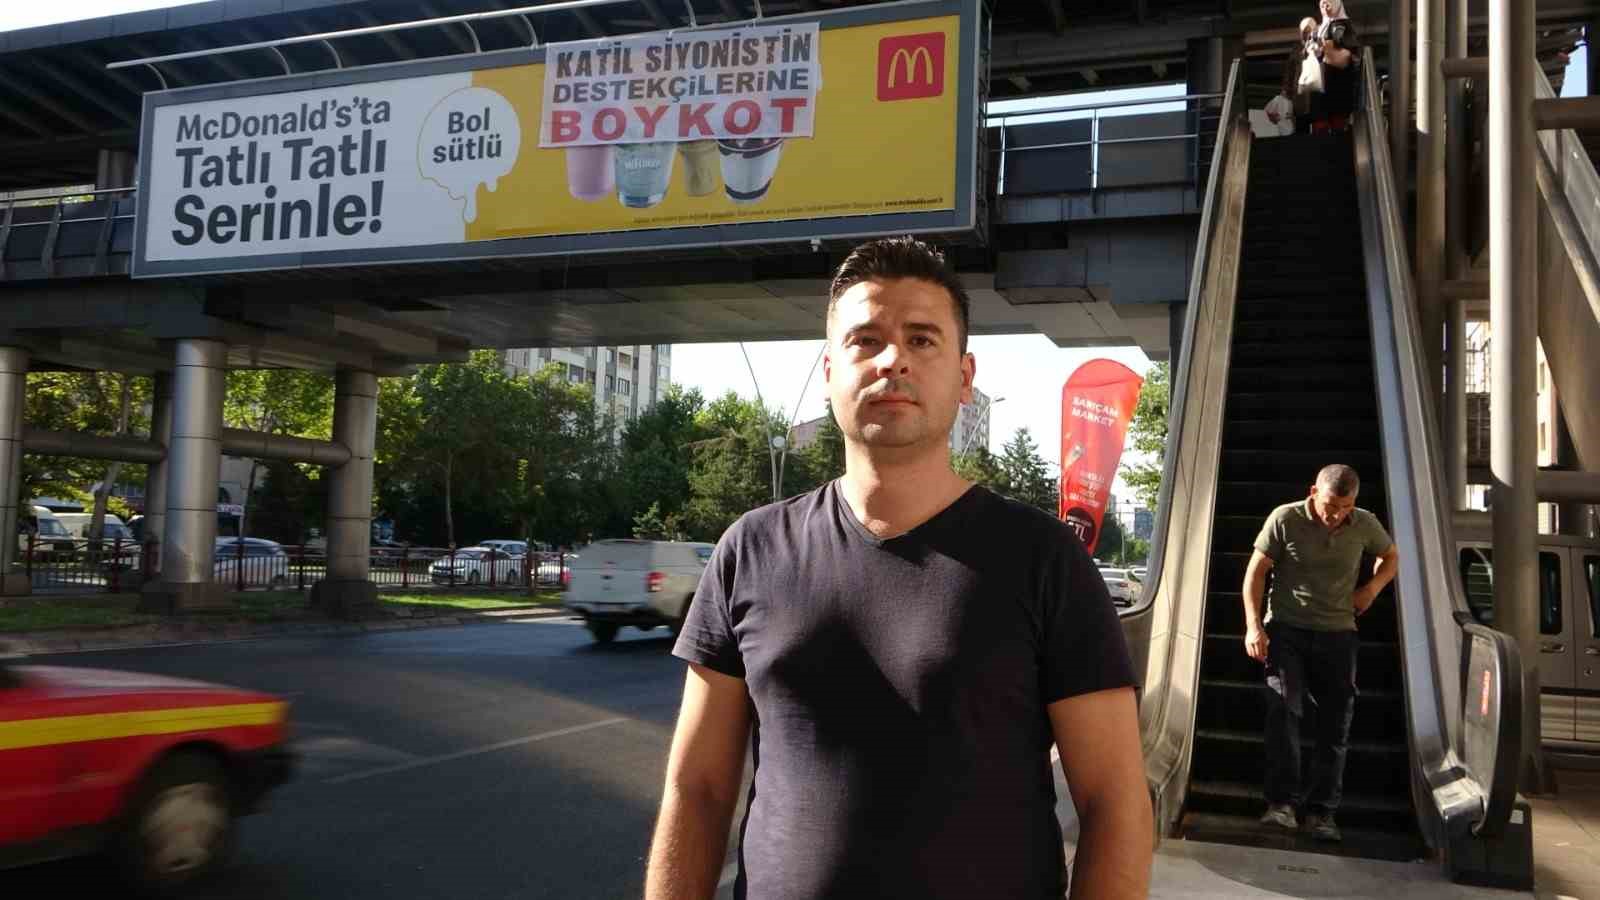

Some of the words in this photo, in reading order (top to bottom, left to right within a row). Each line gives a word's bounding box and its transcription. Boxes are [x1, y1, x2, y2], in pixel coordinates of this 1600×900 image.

[556, 41, 634, 79] KATİL
[645, 28, 812, 73] SİYONİSTİN
[447, 107, 491, 135] Bol
[550, 97, 808, 143] BOYKOT
[175, 141, 270, 188] Tatlı
[283, 129, 387, 181] Tatlı
[432, 133, 502, 164] sütlü
[171, 180, 385, 246] Serinle!
[1071, 407, 1115, 427] MARKET
